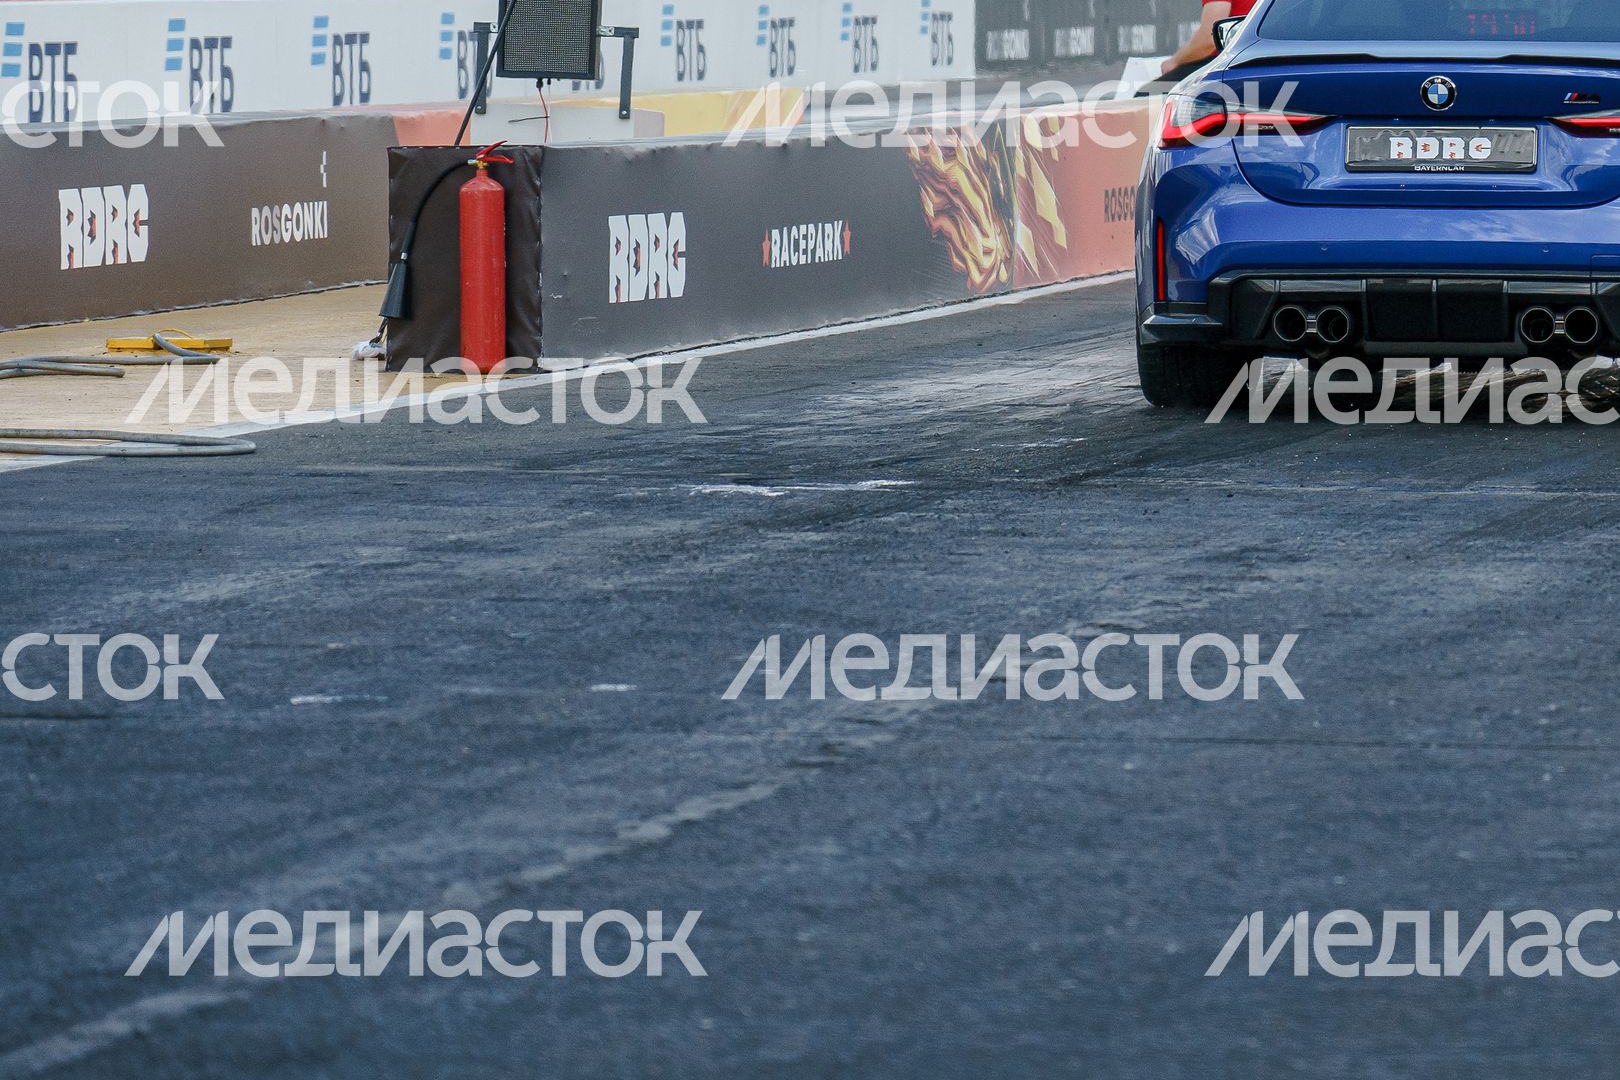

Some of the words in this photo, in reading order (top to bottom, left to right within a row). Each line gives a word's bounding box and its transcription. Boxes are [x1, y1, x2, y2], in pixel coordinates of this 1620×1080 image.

[189, 36, 235, 113] ВТБ
[332, 32, 371, 106] ВТБ
[676, 18, 706, 82] ВТБ
[770, 16, 796, 78] ВТБ
[28, 41, 79, 123] ВТБ
[1389, 136, 1492, 159] RDRC
[59, 184, 149, 270] RDRC
[251, 200, 328, 246] ROSGONKI
[771, 220, 843, 268] RACEPARK
[608, 212, 686, 304] RDRC
